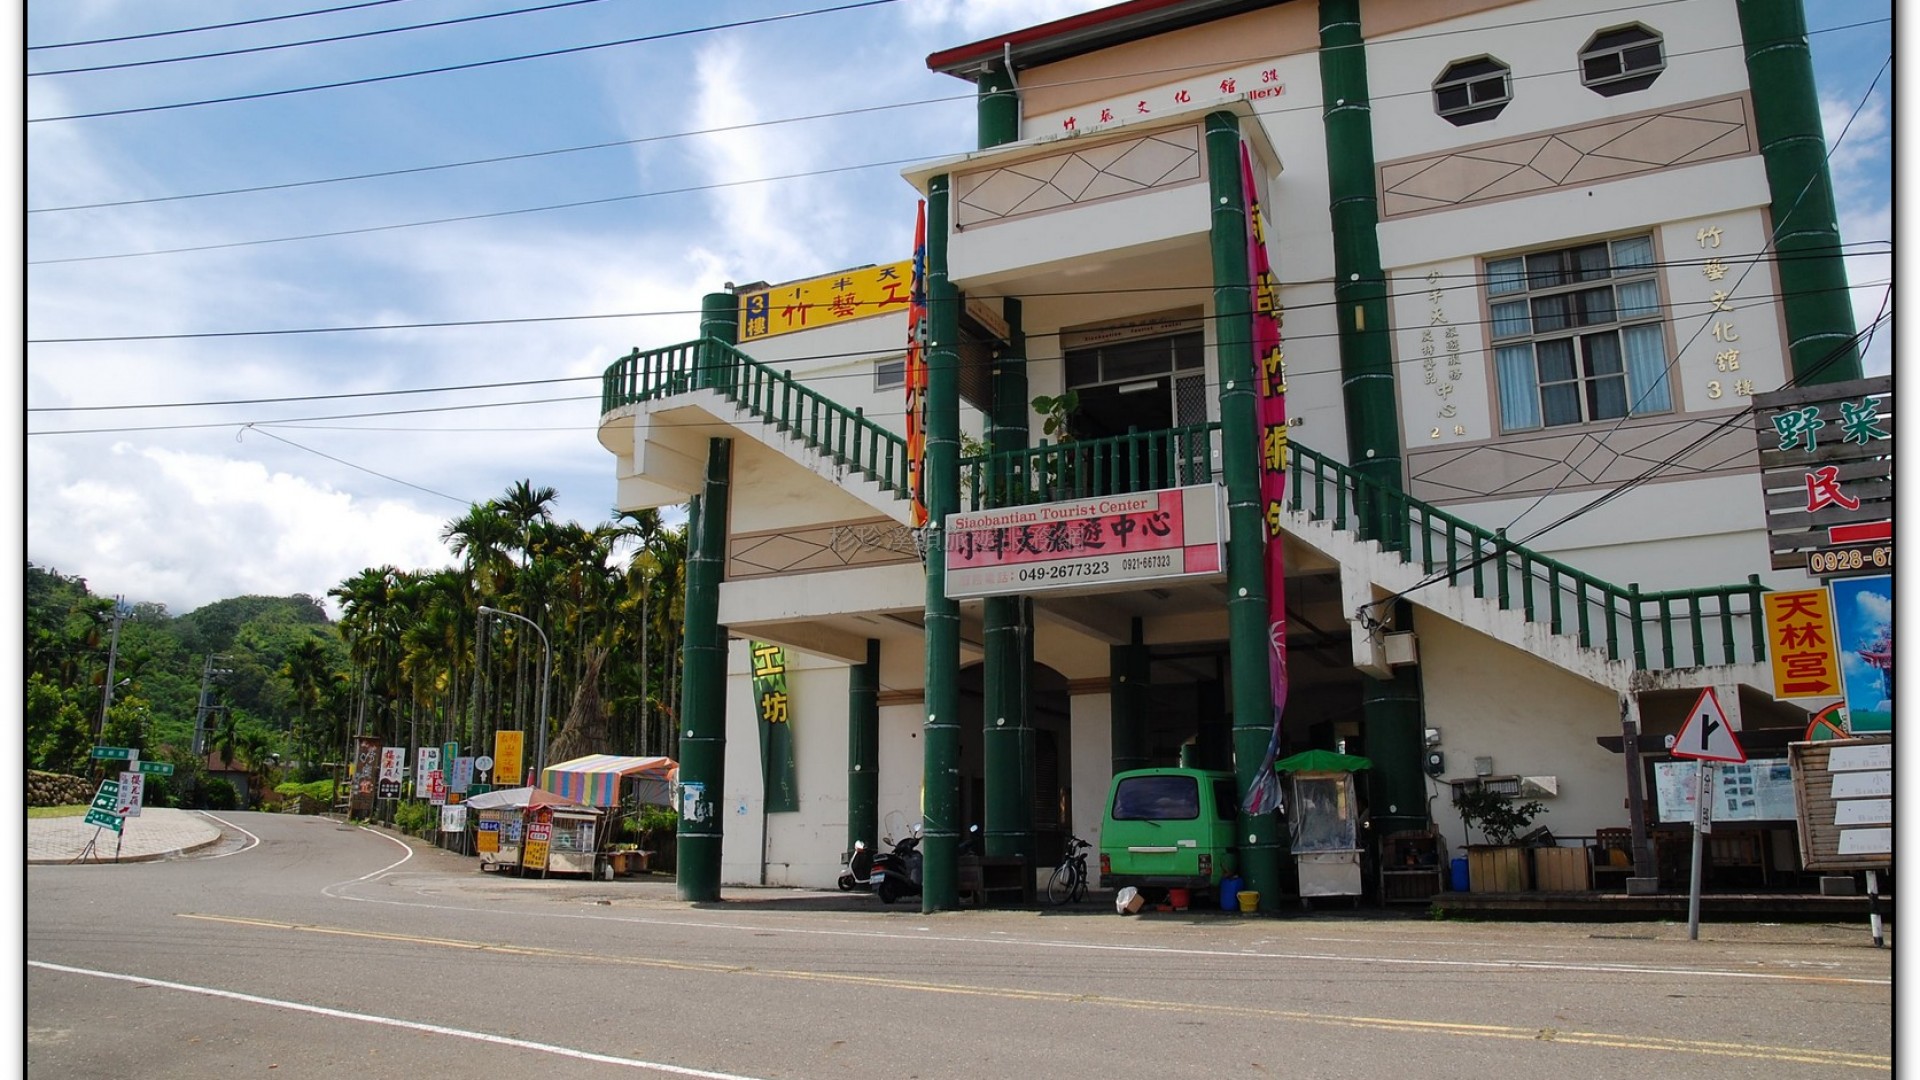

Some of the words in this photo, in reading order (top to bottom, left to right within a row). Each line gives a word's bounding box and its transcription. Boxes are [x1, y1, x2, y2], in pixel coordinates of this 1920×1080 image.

[788, 266, 900, 299] 小半天
[1771, 397, 1890, 452] 野菜
[955, 512, 1037, 530] Siaobantian
[1040, 504, 1097, 520] Tourist
[1099, 497, 1148, 514] Center
[1019, 561, 1110, 583] 049-2677323
[1774, 593, 1828, 679] 天林宮
[754, 646, 788, 723] 工坊
